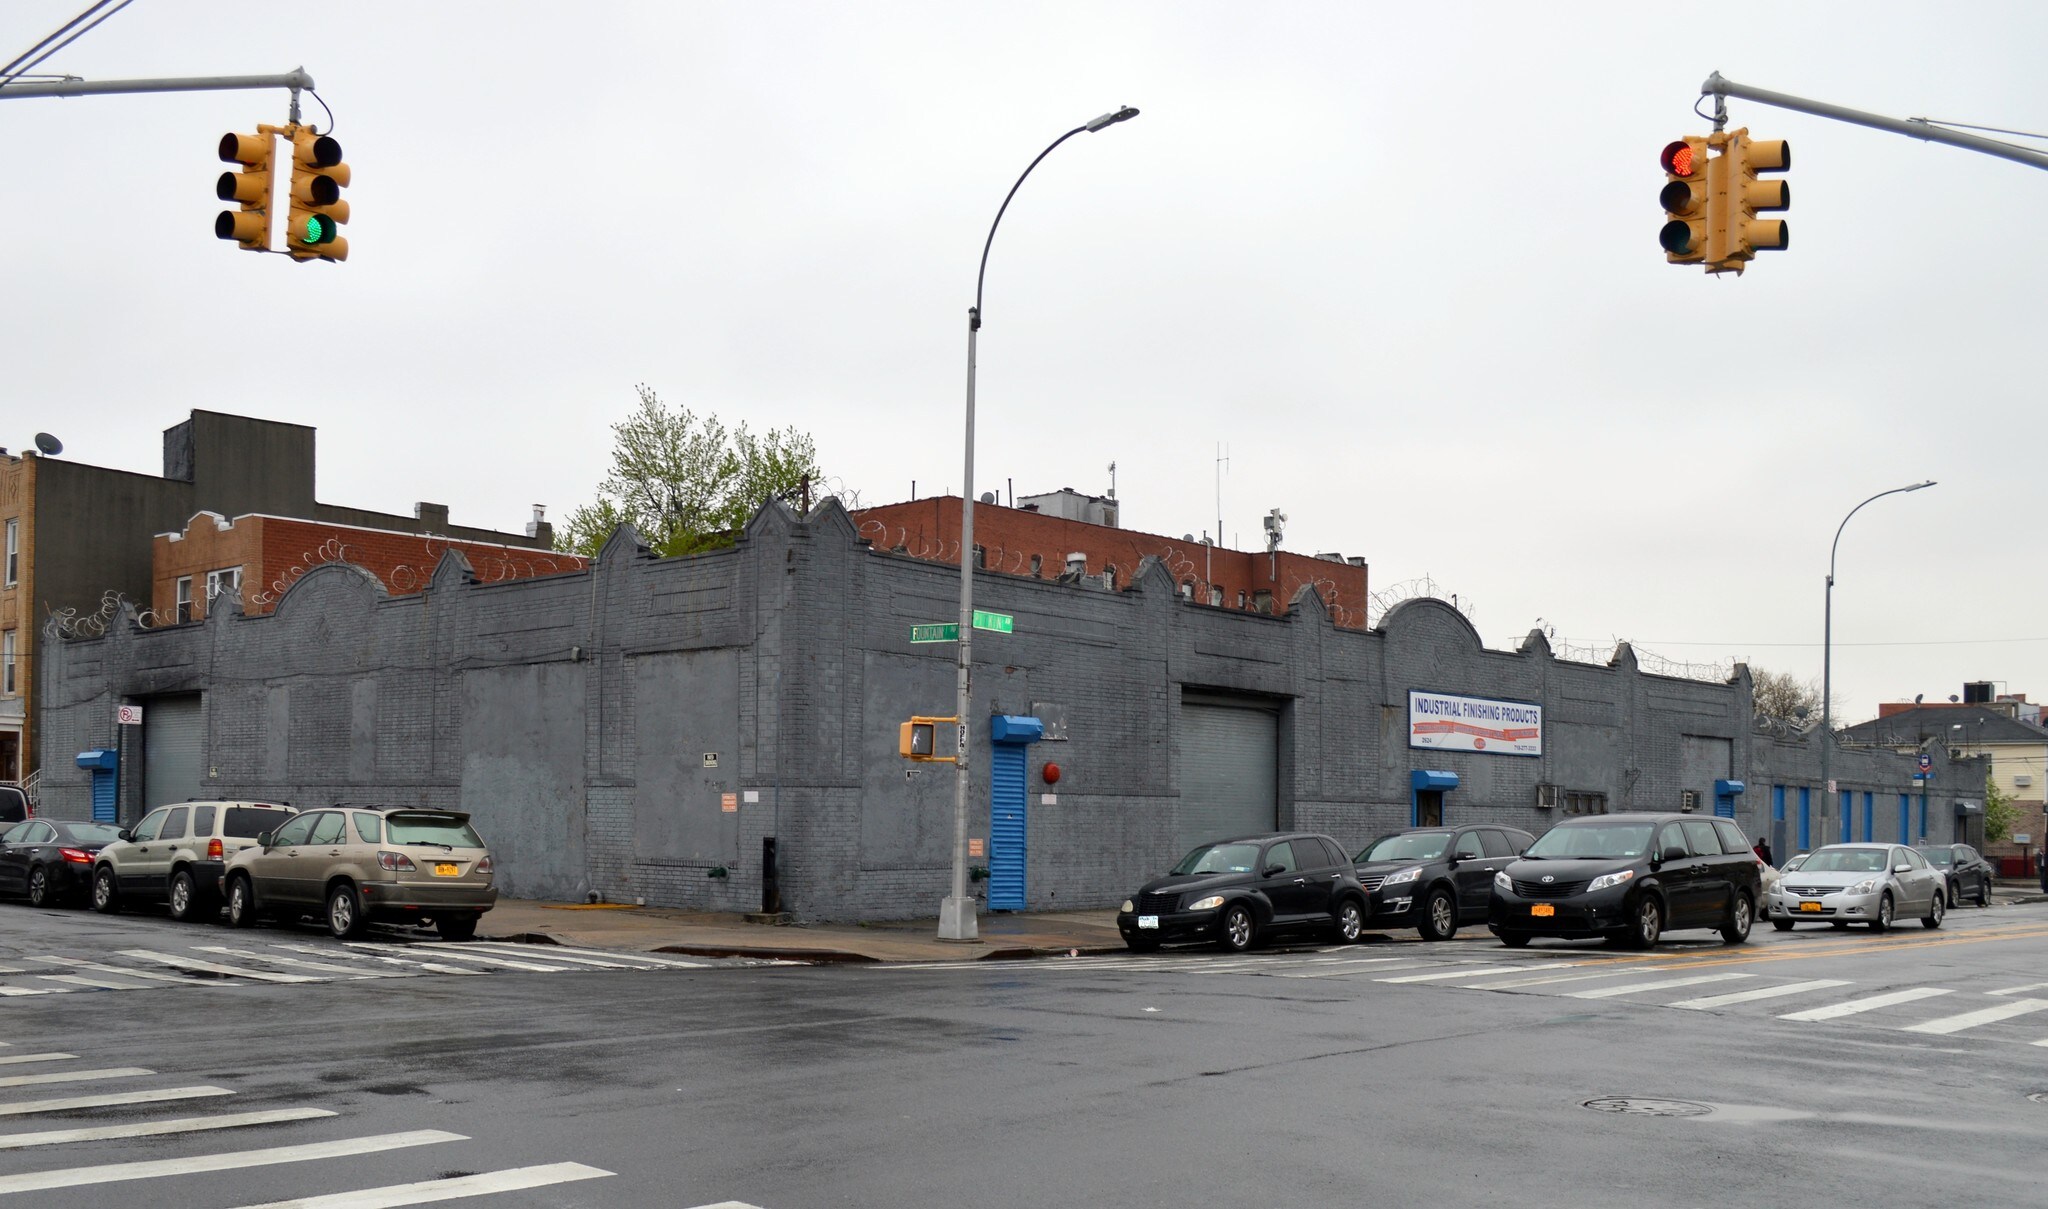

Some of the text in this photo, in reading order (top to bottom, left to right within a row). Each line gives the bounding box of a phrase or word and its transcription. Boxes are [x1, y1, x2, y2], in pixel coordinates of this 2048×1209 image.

[913, 626, 943, 640] FOUNTAIN
[1415, 698, 1538, 724] INDUSTRIAL FINISHING PRODUCTS
